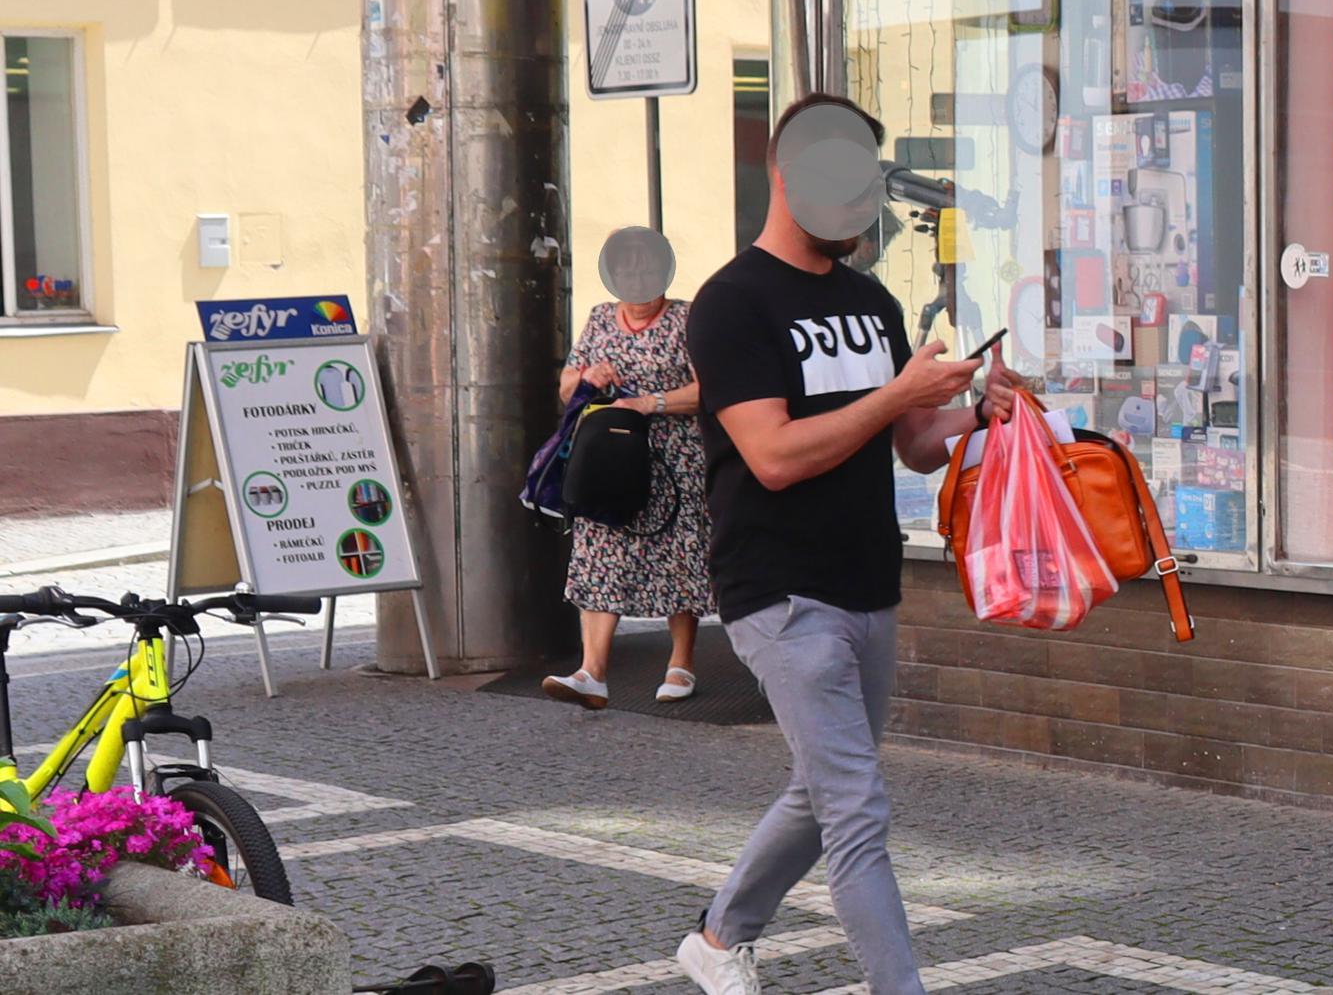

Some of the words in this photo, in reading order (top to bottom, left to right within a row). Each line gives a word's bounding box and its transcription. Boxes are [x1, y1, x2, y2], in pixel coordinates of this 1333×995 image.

[311, 322, 354, 336] Konica
[243, 401, 317, 419] FOTODÁRKY
[274, 426, 309, 439] POTISK
[335, 462, 356, 475] POD
[306, 478, 342, 491] PUZZLE
[266, 516, 316, 533] PRODEJ
[282, 550, 326, 565] FOTOALB
